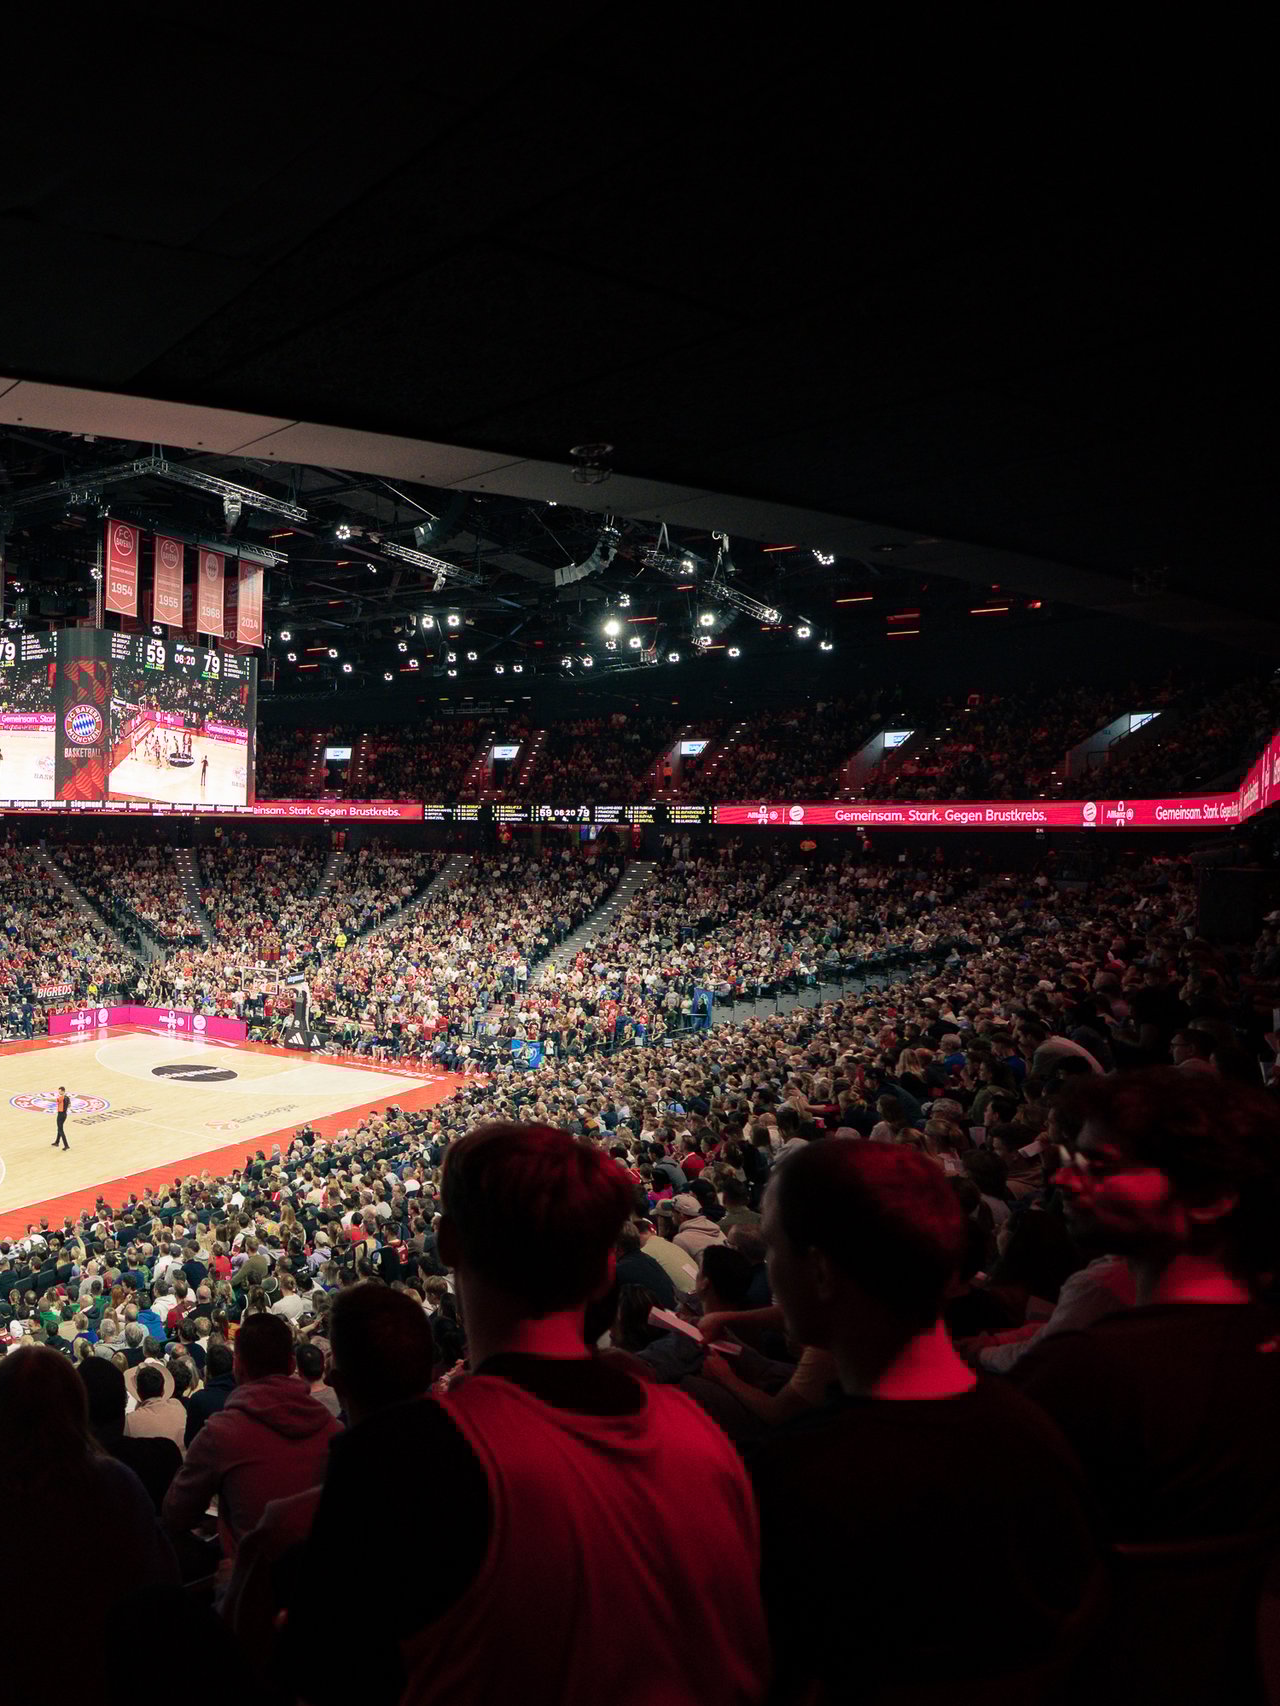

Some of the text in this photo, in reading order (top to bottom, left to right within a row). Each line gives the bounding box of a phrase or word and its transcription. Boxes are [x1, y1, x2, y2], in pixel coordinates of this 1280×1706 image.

[111, 581, 133, 597] 1954
[158, 594, 179, 608] 1955
[201, 606, 220, 619] 1968
[241, 617, 258, 630] 2014
[146, 644, 166, 664] 59
[174, 653, 196, 666] 06:20
[203, 654, 220, 673] 79
[1, 714, 39, 723] Gemeinsam.
[75, 706, 100, 722] BAYERN
[64, 747, 101, 758] BASKETBALL
[70, 800, 102, 809] siegmund
[288, 806, 315, 816] Stark.
[317, 806, 347, 817] Gegen
[349, 806, 401, 817] Brustkrebs.
[539, 809, 552, 817] 59
[577, 809, 590, 817] 79
[834, 808, 1047, 824] Gemeinsam. Stark. Gegen Brustkrebs.
[1155, 804, 1202, 820] Gemeinsam.
